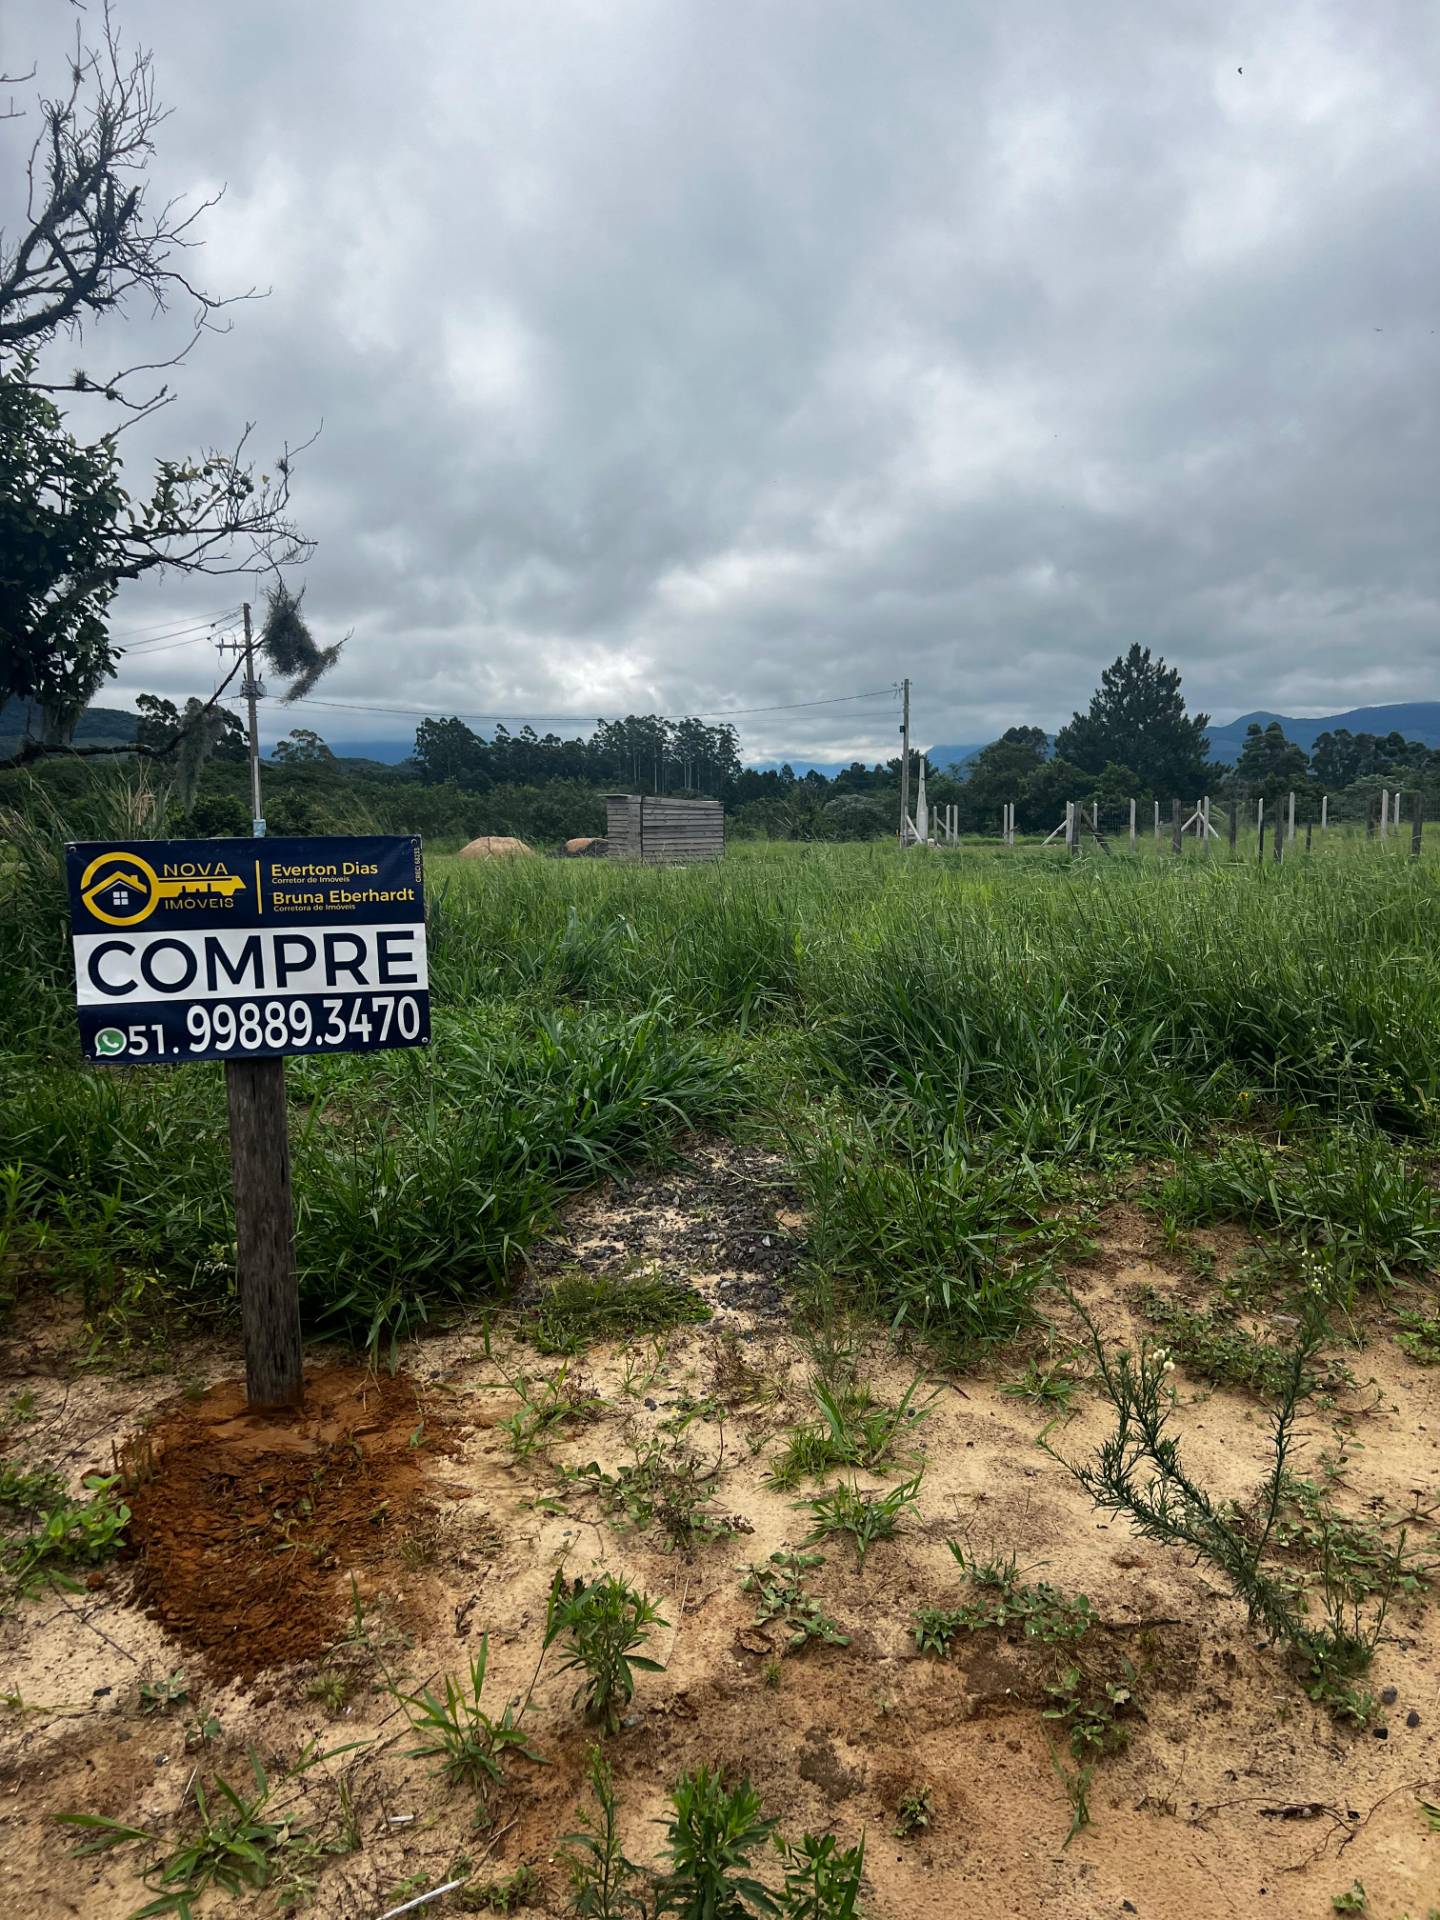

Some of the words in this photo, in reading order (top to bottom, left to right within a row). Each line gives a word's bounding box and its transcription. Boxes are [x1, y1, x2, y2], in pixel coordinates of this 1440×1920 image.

[163, 862, 229, 877] NOVA
[271, 863, 337, 877] Everton
[342, 861, 379, 875] Dias
[306, 876, 318, 884] de
[272, 891, 325, 905] Bruna
[329, 888, 415, 903] Eberhardt
[87, 930, 418, 997] COMPRE
